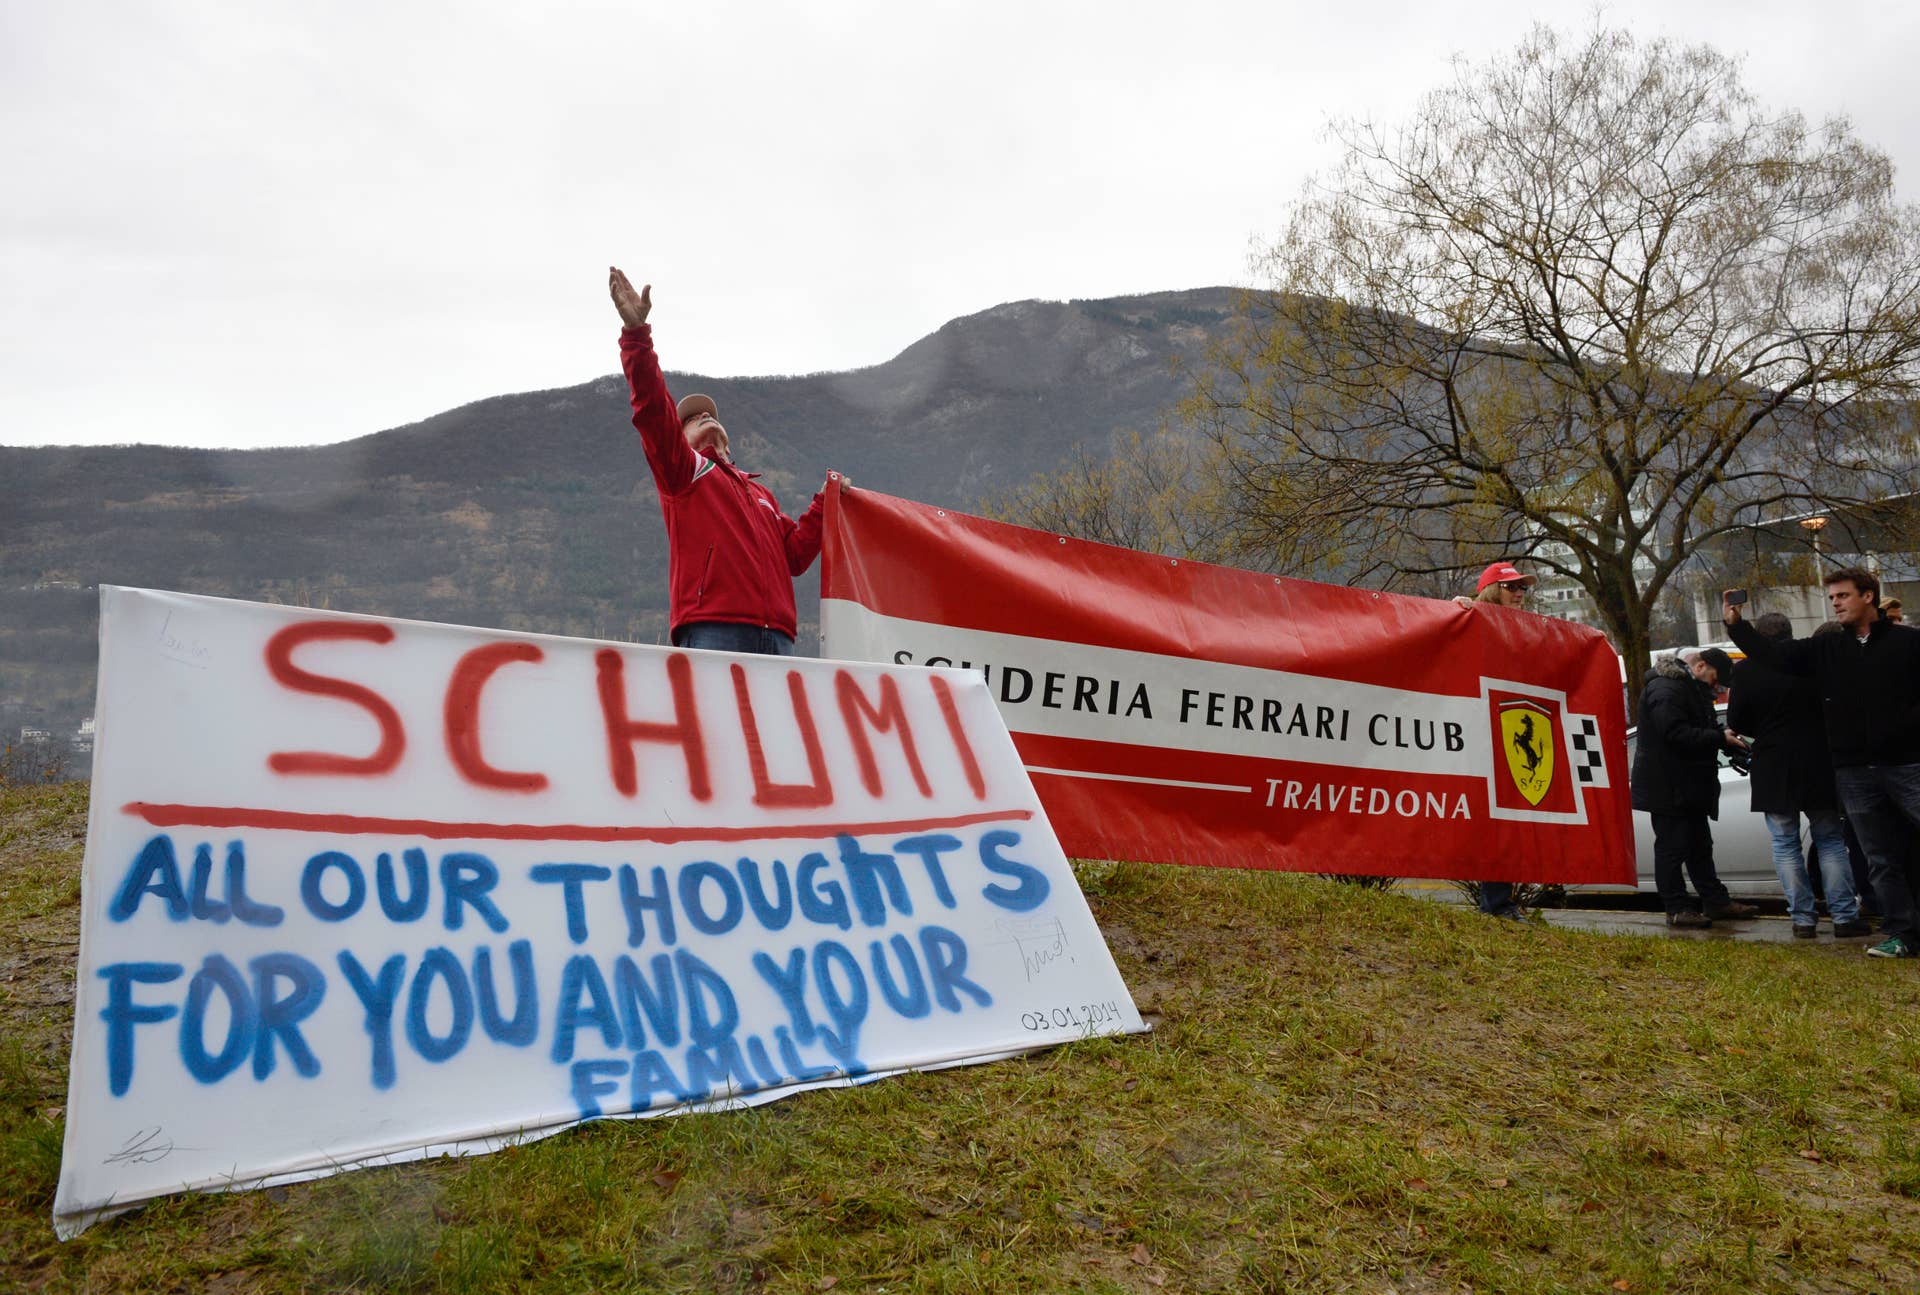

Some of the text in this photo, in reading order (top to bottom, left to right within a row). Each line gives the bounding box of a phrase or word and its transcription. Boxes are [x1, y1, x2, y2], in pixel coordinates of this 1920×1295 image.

[266, 619, 985, 808] SCHUMI
[894, 650, 1465, 752] DERIA FERRARI CLUB
[1265, 777, 1472, 820] TRAVEDONA
[107, 832, 284, 928] ALL
[299, 845, 510, 934] OUR
[98, 952, 328, 1100] FOR
[334, 936, 542, 1092] YOU
[549, 946, 740, 1065] AND
[750, 922, 994, 1048] YOUR
[1021, 1000, 1122, 1031] 03.01.2014
[570, 1022, 867, 1119] FAMILY
